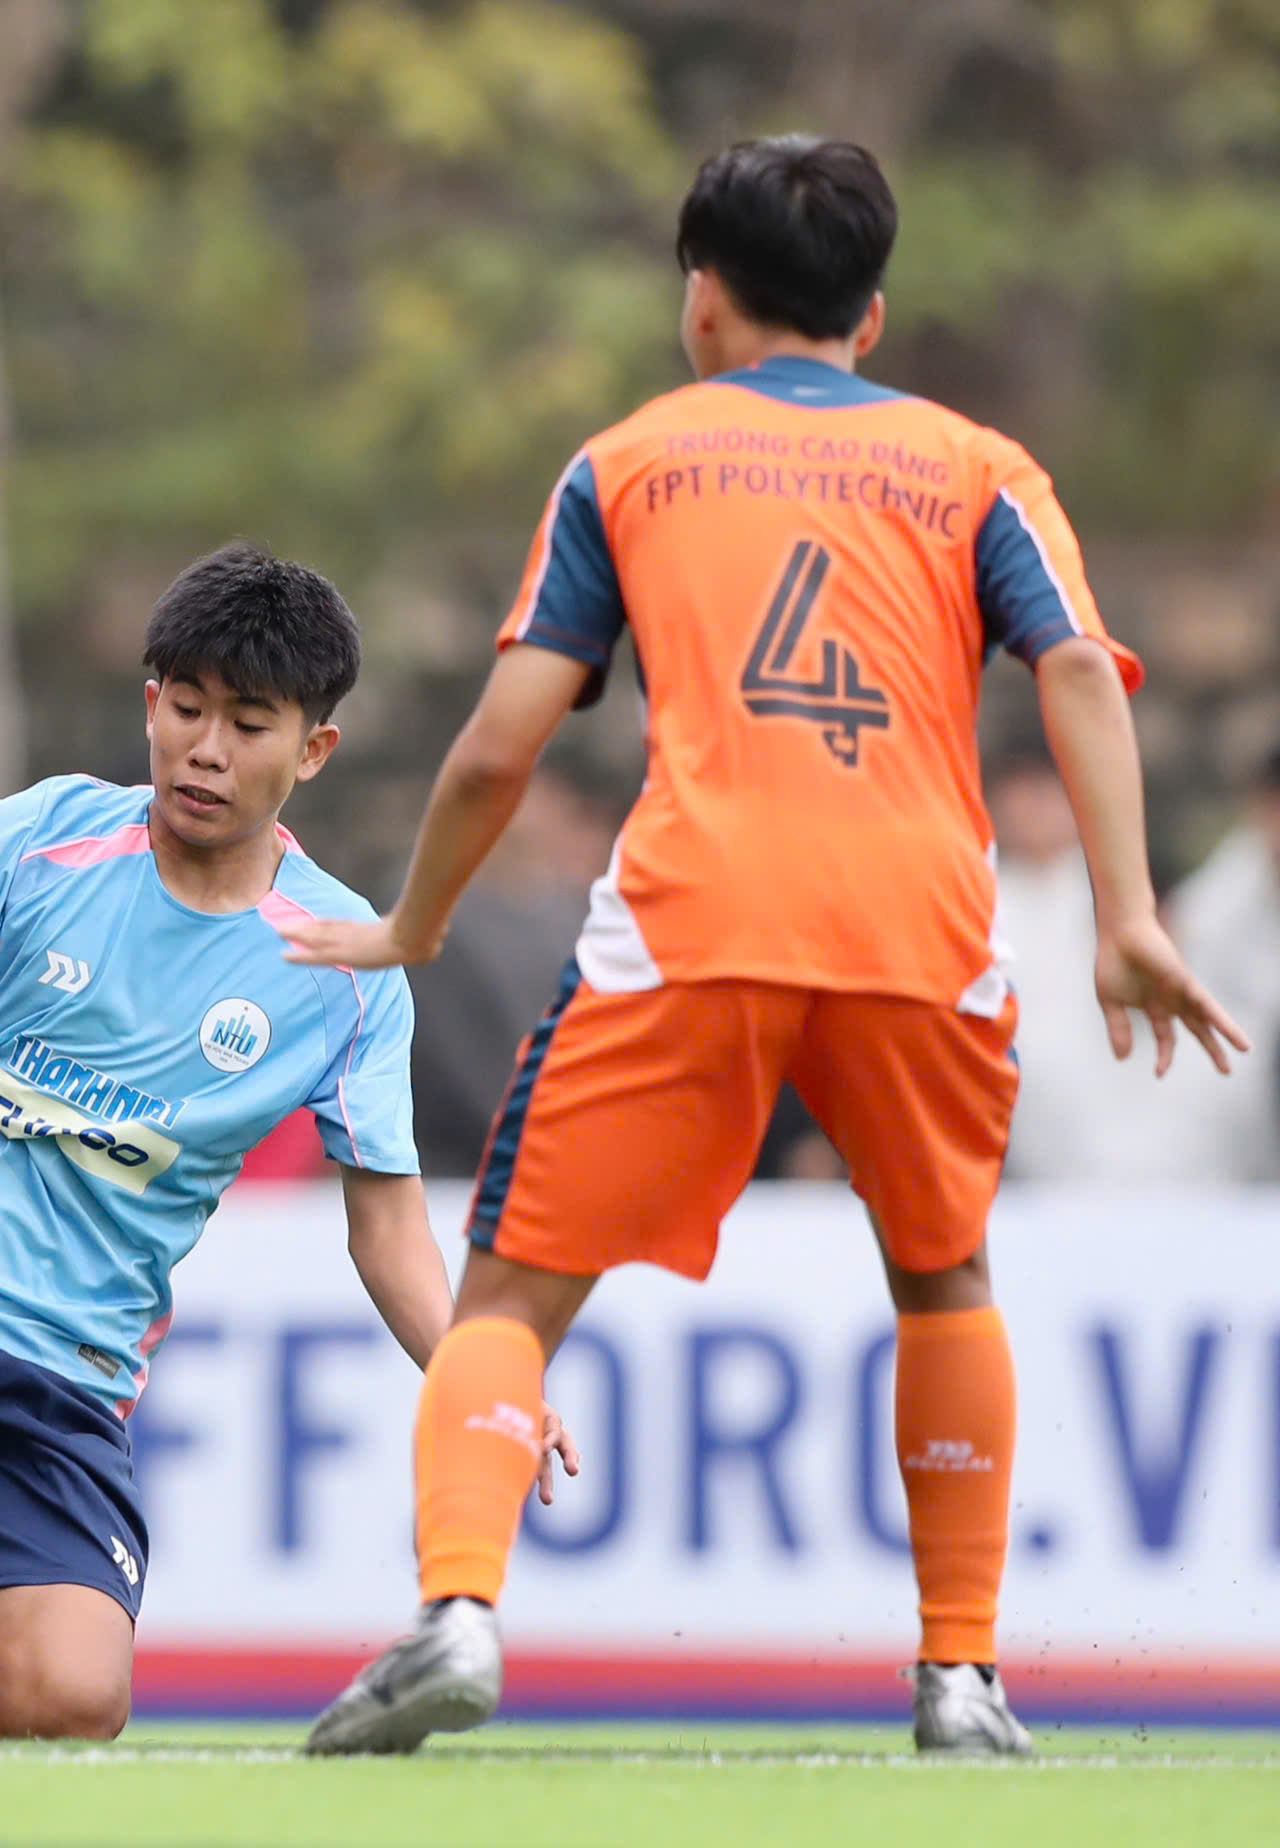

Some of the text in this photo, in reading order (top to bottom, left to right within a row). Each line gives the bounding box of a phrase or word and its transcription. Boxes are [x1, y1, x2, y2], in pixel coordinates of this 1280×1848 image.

[800, 436, 860, 460] CAO
[646, 464, 704, 514] FPT
[741, 540, 890, 769] 4
[212, 1027, 252, 1055] NTU
